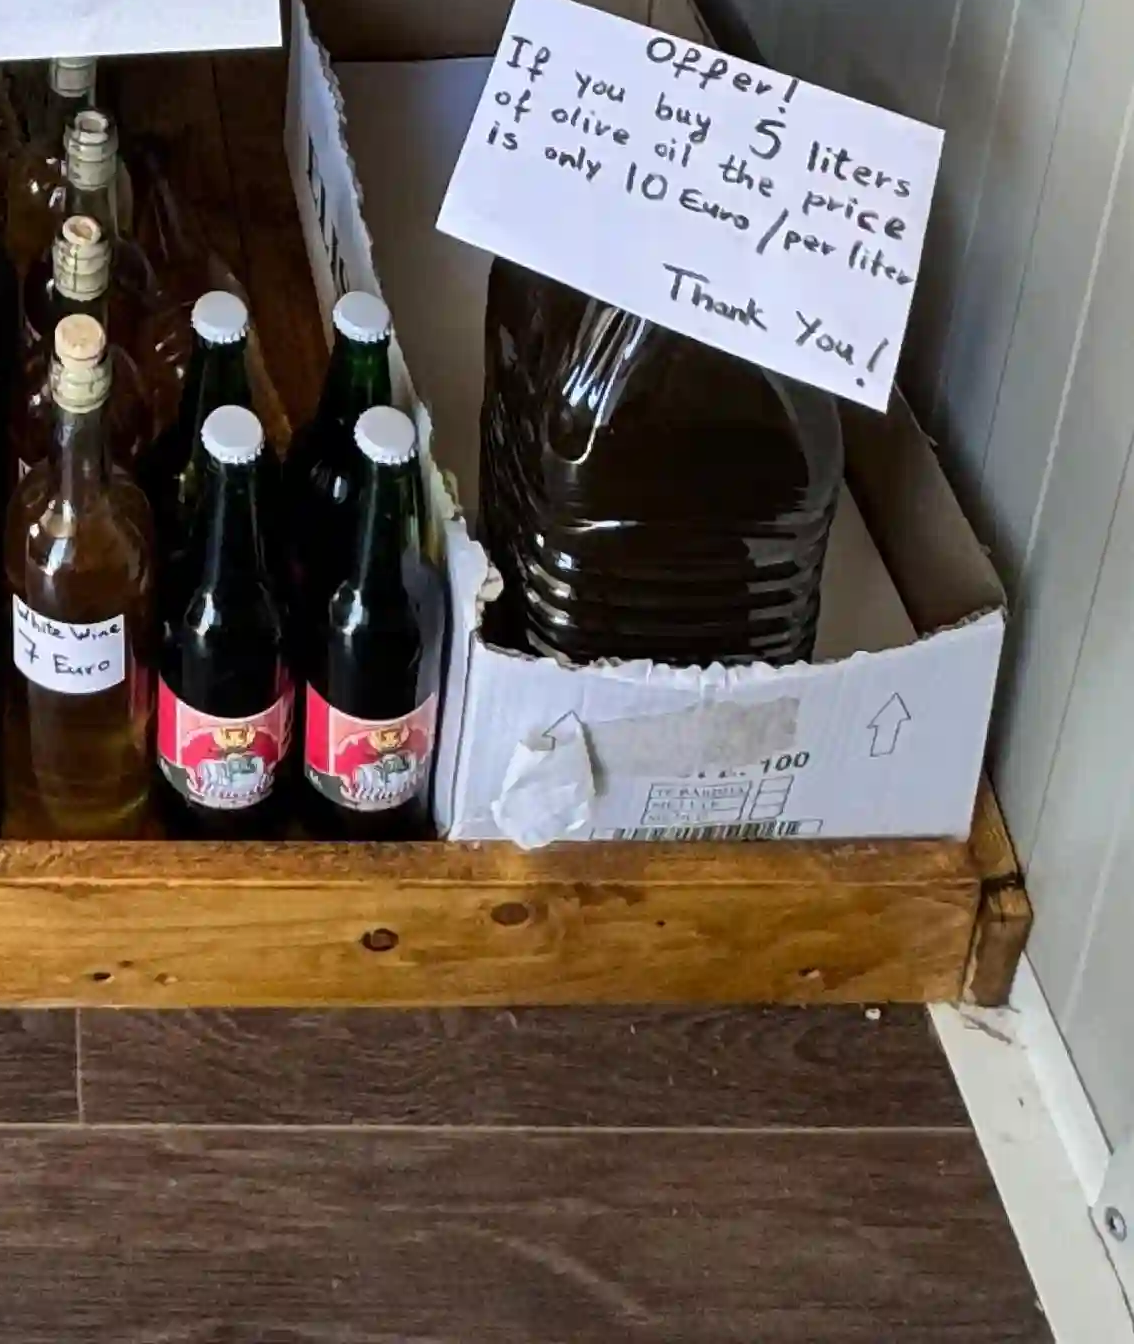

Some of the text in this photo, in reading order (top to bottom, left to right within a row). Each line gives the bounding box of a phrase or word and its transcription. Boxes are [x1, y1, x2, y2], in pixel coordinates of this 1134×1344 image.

[506, 35, 911, 198] If you buy 5 liters
[646, 36, 800, 114] Offer!
[487, 123, 518, 151] is
[545, 146, 602, 181] only
[626, 162, 669, 201] 10
[847, 241, 915, 286] liter
[495, 89, 907, 240] of olive oil the price
[663, 262, 890, 388] Thank You!
[18, 627, 110, 675] 7 Euro
[69, 624, 121, 640] Wine
